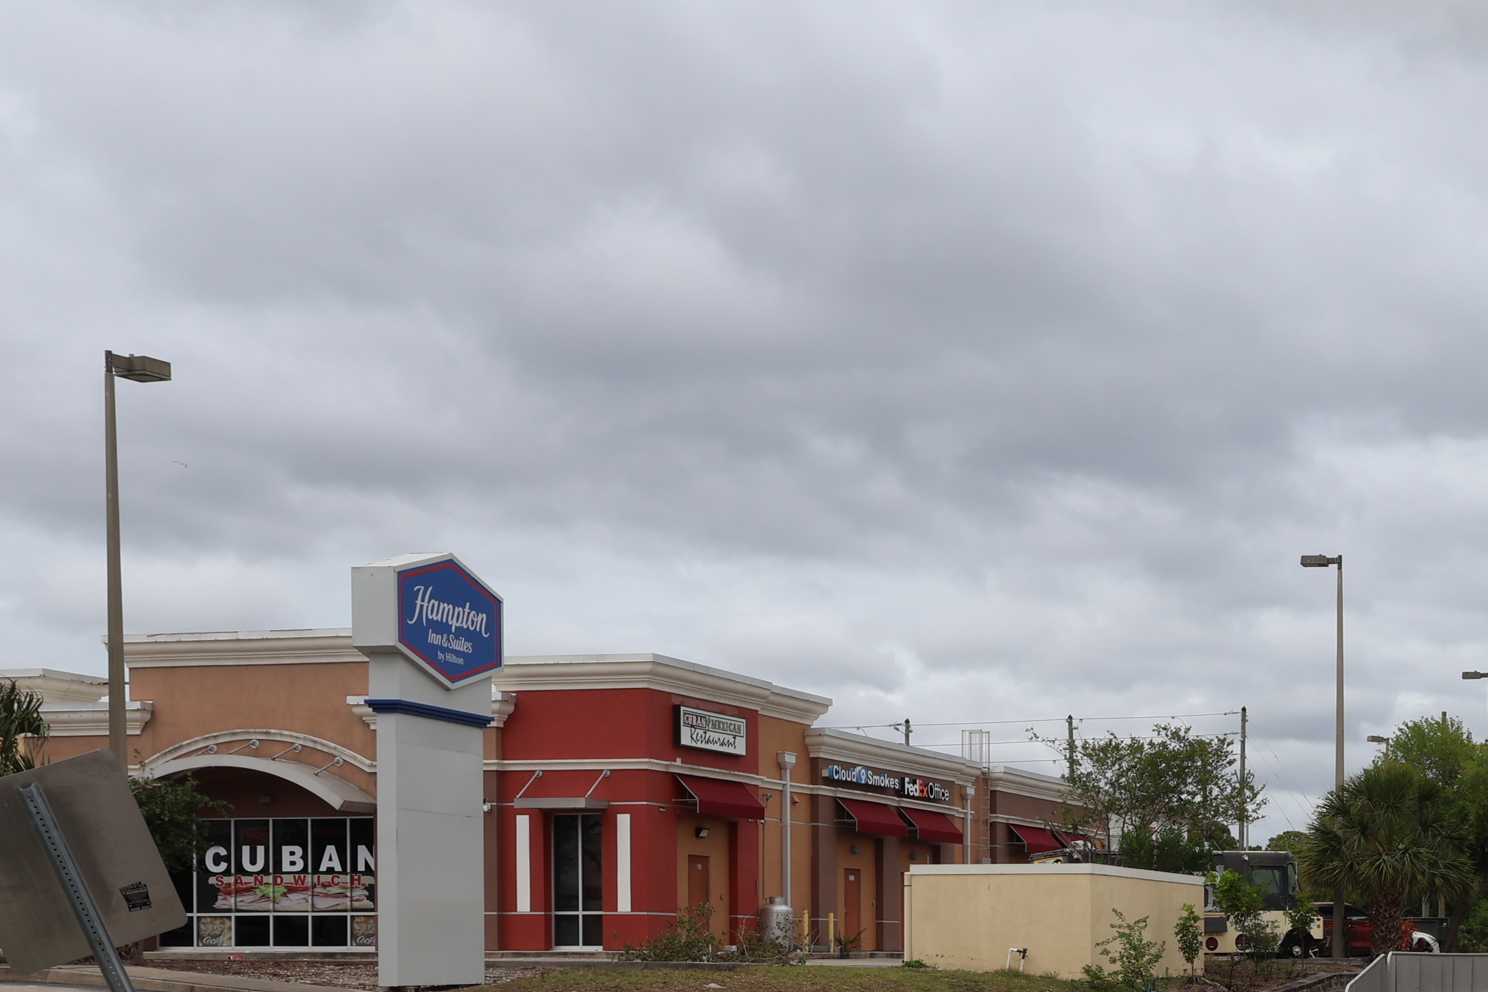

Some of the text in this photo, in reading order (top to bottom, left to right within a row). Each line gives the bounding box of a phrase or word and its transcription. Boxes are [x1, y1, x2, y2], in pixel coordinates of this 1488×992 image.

[406, 585, 490, 638] Hampton
[437, 650, 464, 665] by Hilton
[832, 764, 857, 783] Cloud
[867, 770, 900, 789] Smokes
[904, 777, 950, 801] FedEx Office
[205, 844, 375, 873] CUBAN
[215, 874, 361, 887] SANDWICH
